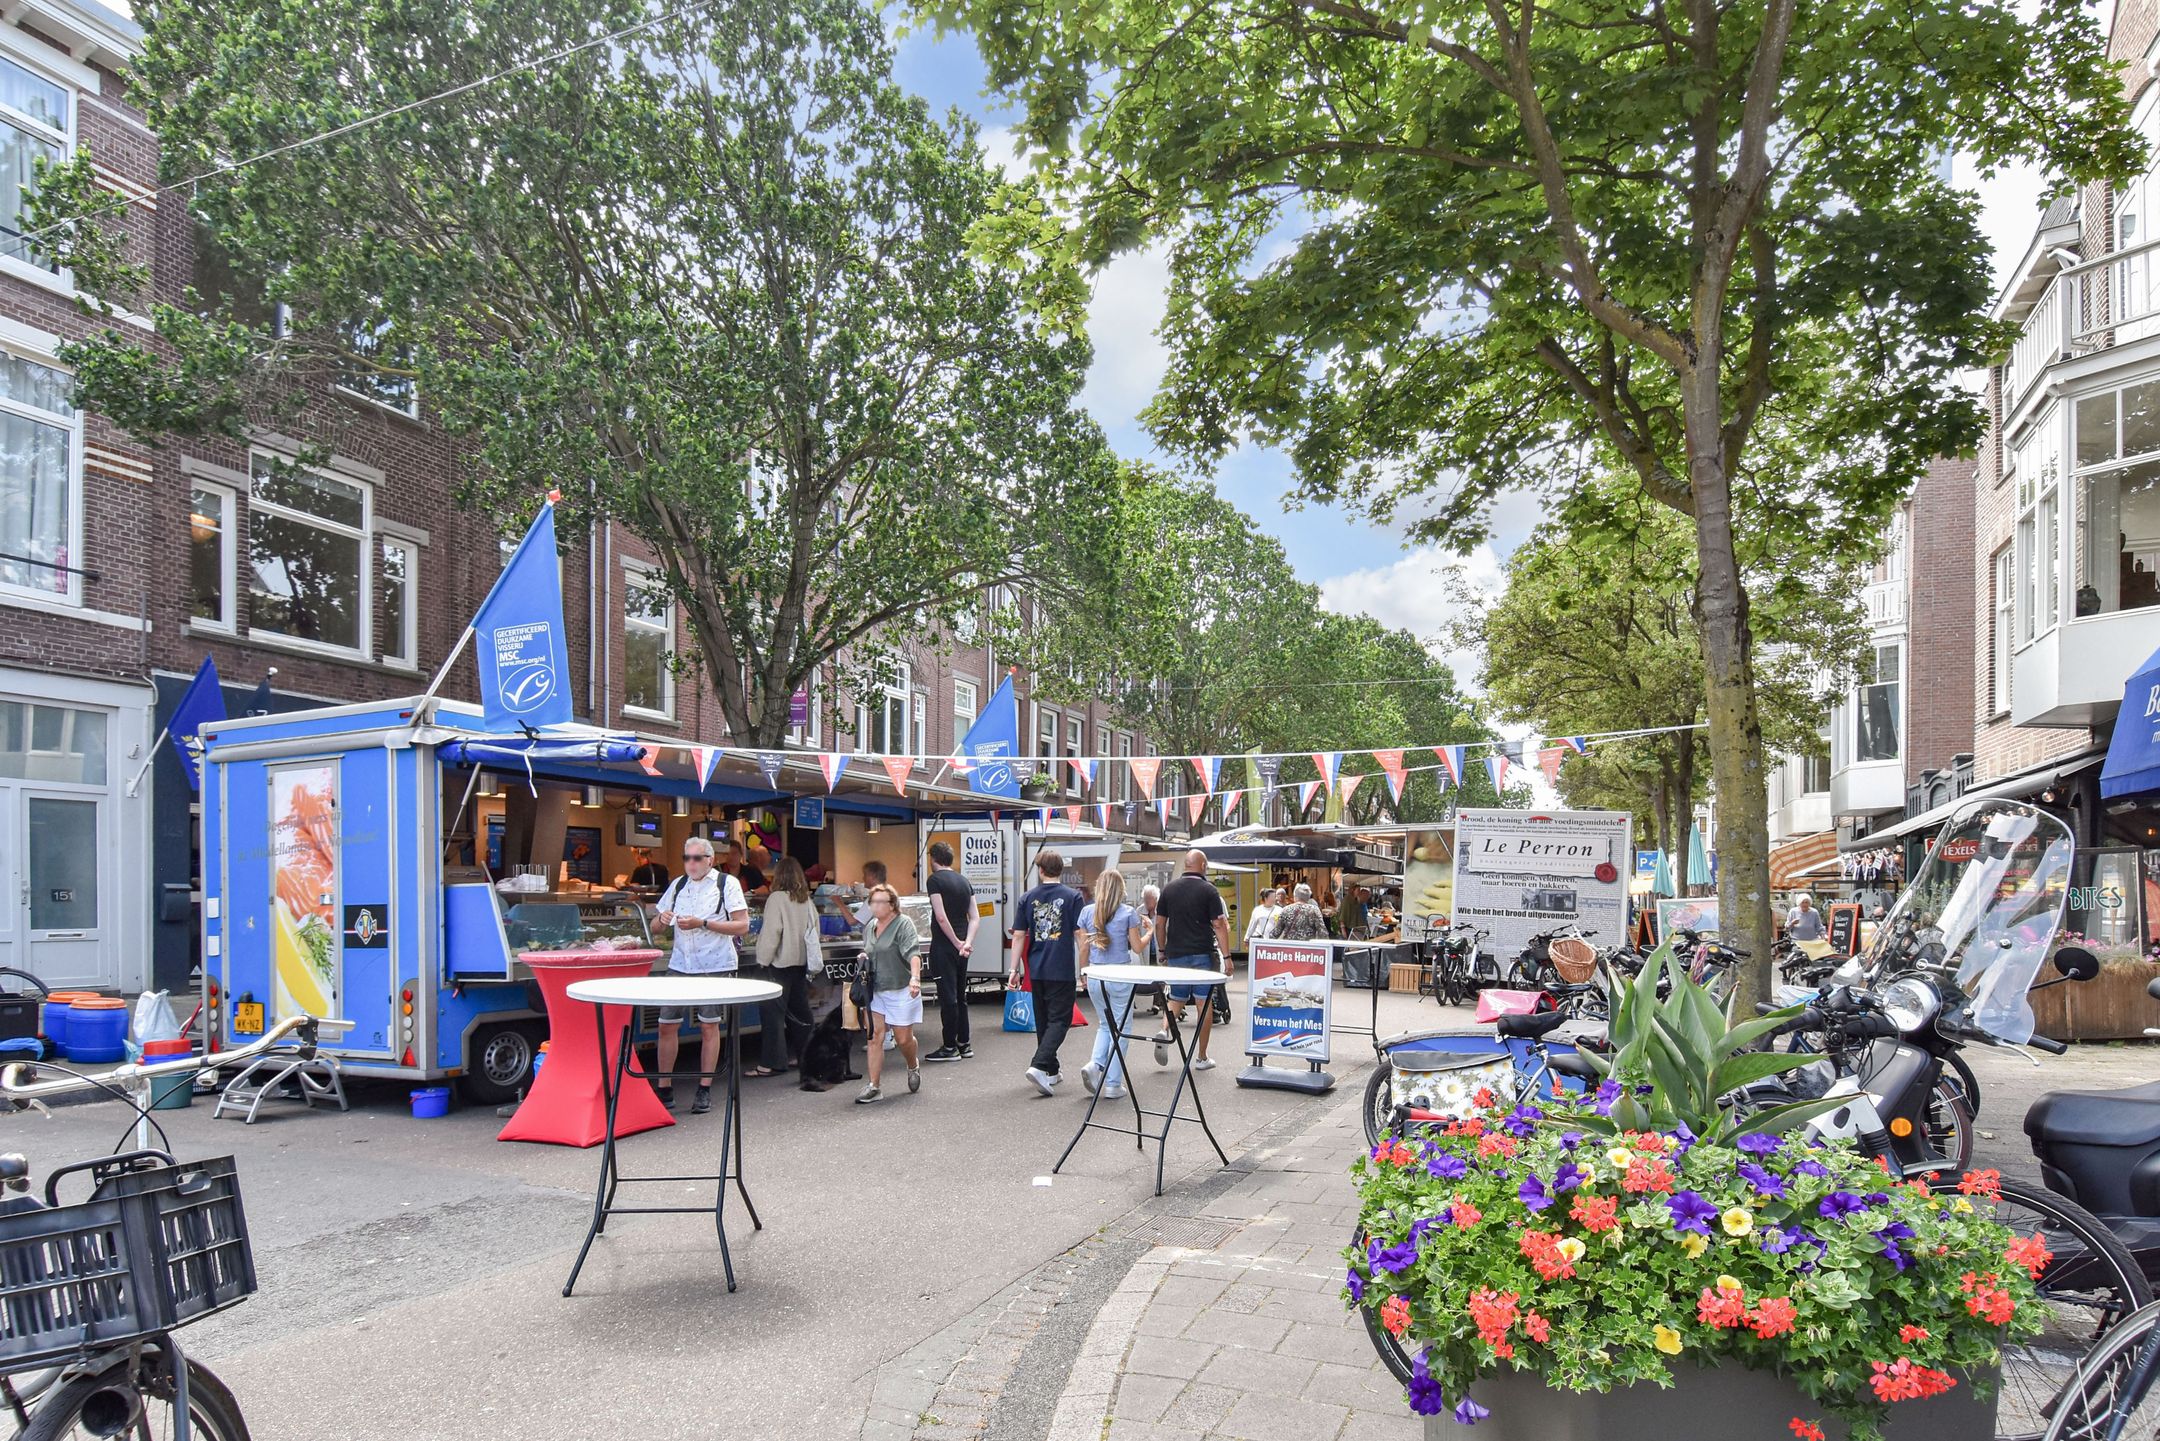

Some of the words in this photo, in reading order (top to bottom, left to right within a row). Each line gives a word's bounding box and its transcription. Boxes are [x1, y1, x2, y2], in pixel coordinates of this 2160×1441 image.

[496, 625, 548, 638] GECERTIFICEERD
[498, 634, 534, 645] DUURZAME
[500, 650, 520, 662] MSC
[500, 656, 546, 667] www.msc.org/nl
[966, 836, 997, 850] Otto's
[1483, 838, 1507, 853] Le
[1517, 840, 1593, 856] Perron
[1943, 845, 1976, 856] TEXELS
[966, 851, 998, 865] Satéh
[54, 891, 73, 901] 151
[2068, 886, 2122, 910] BITES
[1472, 908, 1491, 916] heeft
[1506, 910, 1526, 918] brood
[1528, 911, 1579, 920] uitgevonden?
[1257, 949, 1293, 962] Maatjes
[1294, 952, 1324, 965] Haring
[1254, 1015, 1271, 1026] Vers
[1272, 1019, 1287, 1028] van
[1289, 1018, 1303, 1029] het
[1304, 1020, 1323, 1031] Mes
